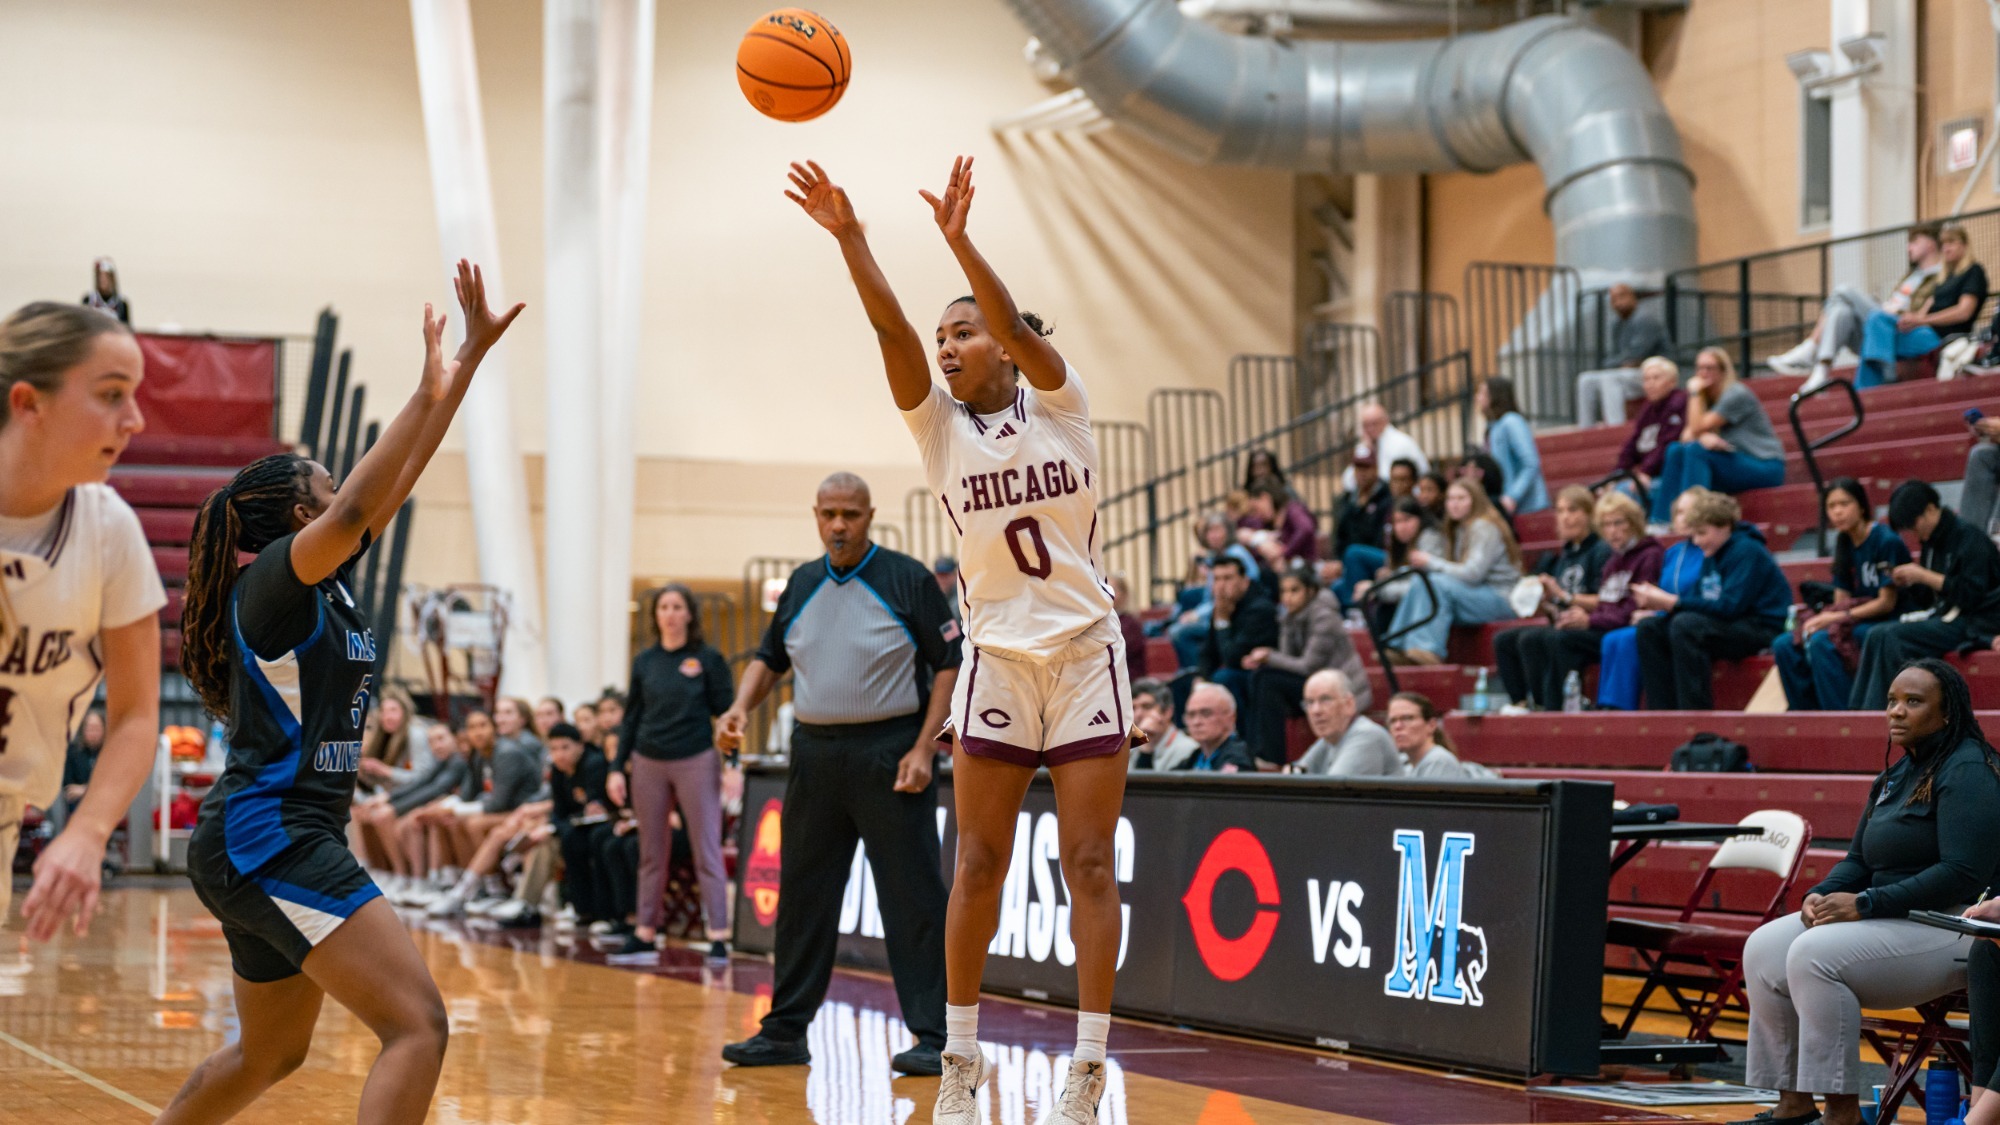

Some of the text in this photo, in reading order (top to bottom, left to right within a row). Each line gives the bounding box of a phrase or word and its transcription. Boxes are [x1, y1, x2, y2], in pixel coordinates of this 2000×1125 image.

[1004, 515, 1052, 581] 0
[979, 708, 1012, 729] C
[1181, 827, 1281, 981] C
[1307, 878, 1371, 968] VS.
[1385, 829, 1475, 1005] M
